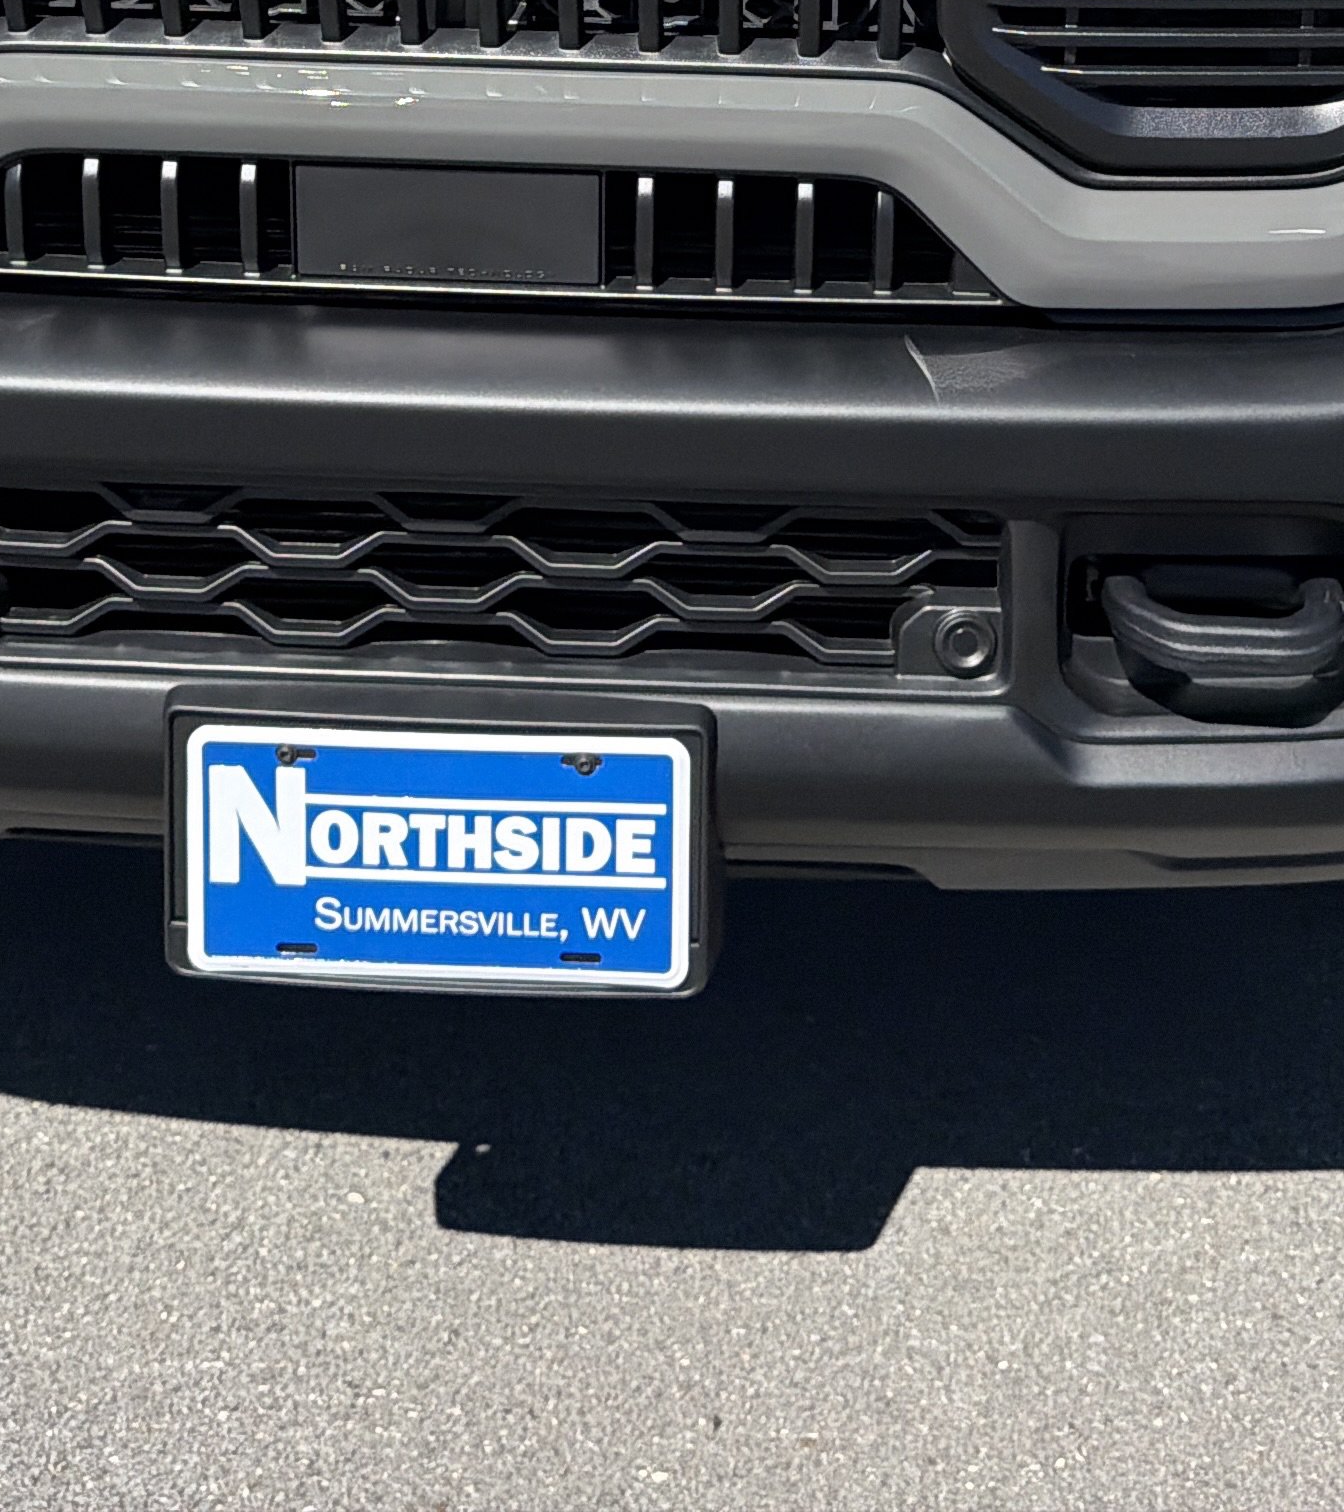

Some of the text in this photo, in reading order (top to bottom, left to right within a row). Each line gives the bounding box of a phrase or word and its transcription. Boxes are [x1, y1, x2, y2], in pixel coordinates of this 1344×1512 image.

[207, 762, 657, 886] NORTHSIDE
[314, 896, 646, 943] SUMMERSVILLE, WV
